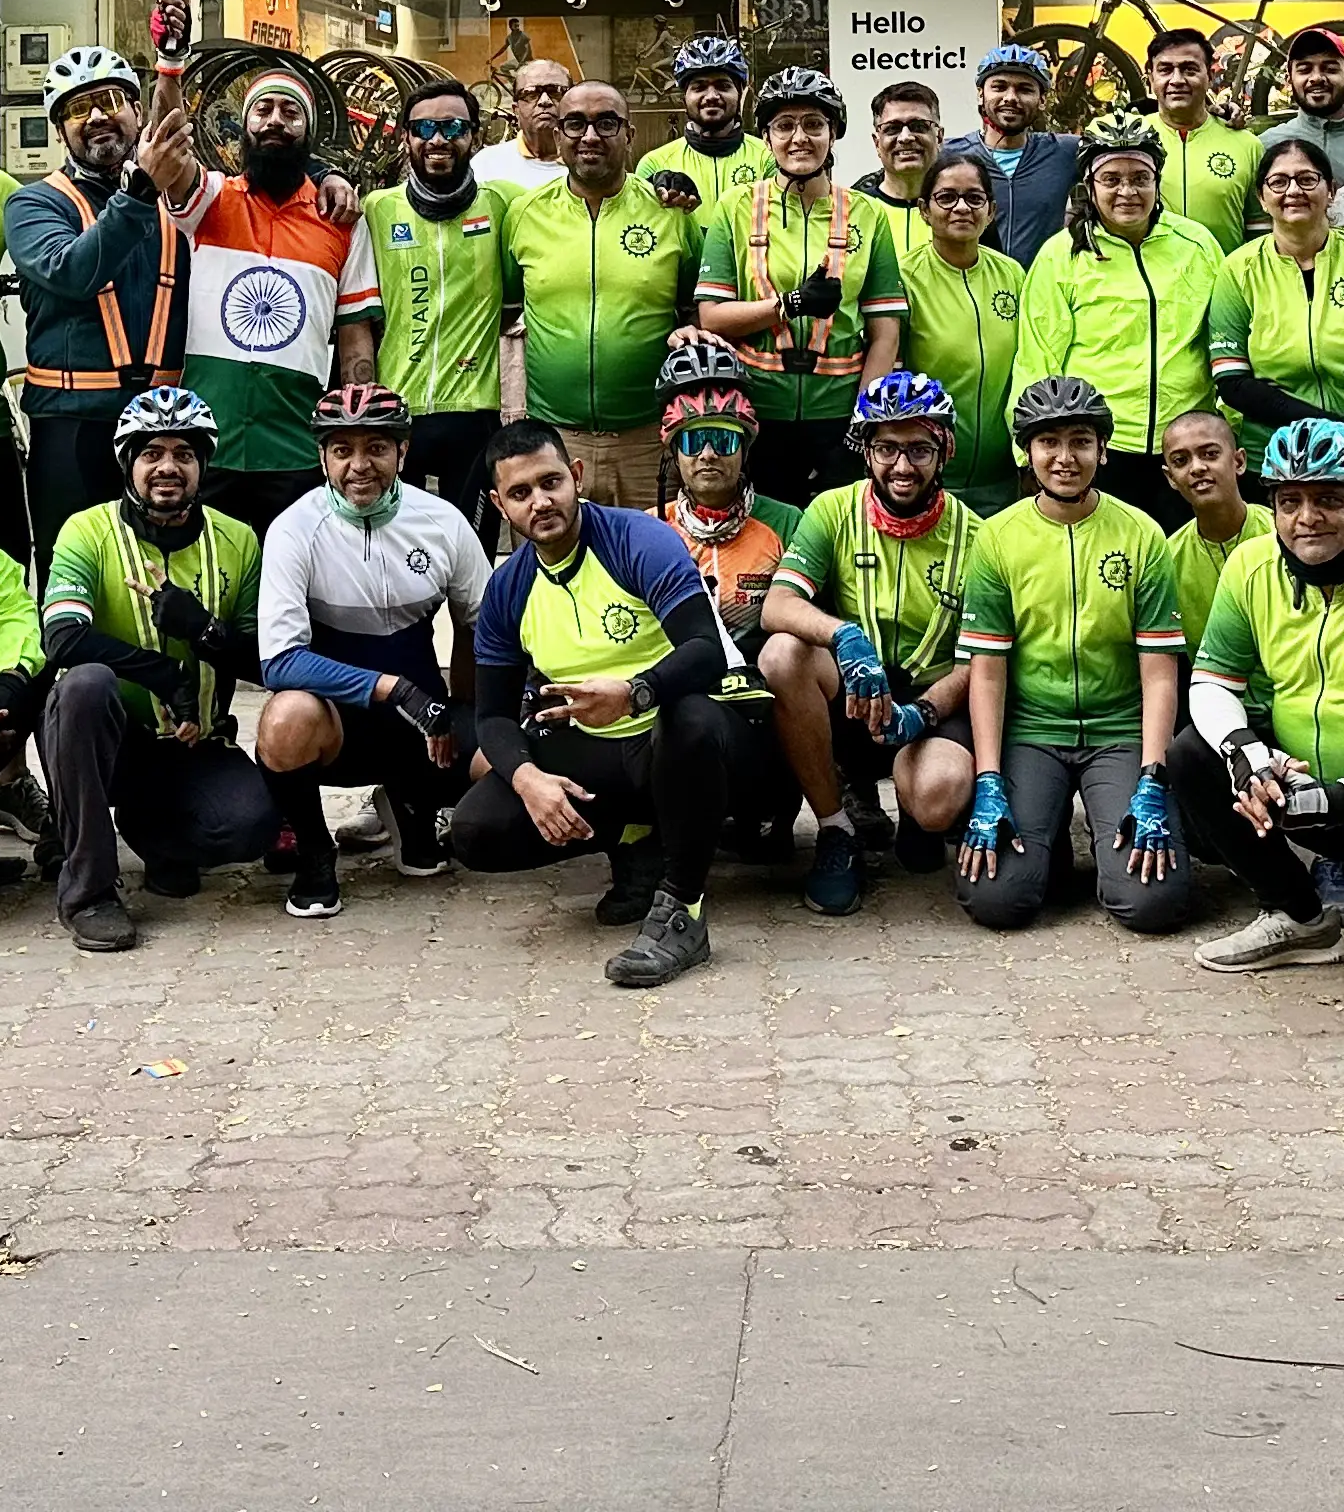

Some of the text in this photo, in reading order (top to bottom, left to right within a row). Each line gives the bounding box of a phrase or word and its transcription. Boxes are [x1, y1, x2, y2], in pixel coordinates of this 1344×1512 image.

[250, 19, 293, 50] FIREFOX
[851, 11, 926, 35] Hello
[851, 44, 968, 71] electric!
[408, 265, 429, 364] ANAND
[722, 675, 750, 694] 91
